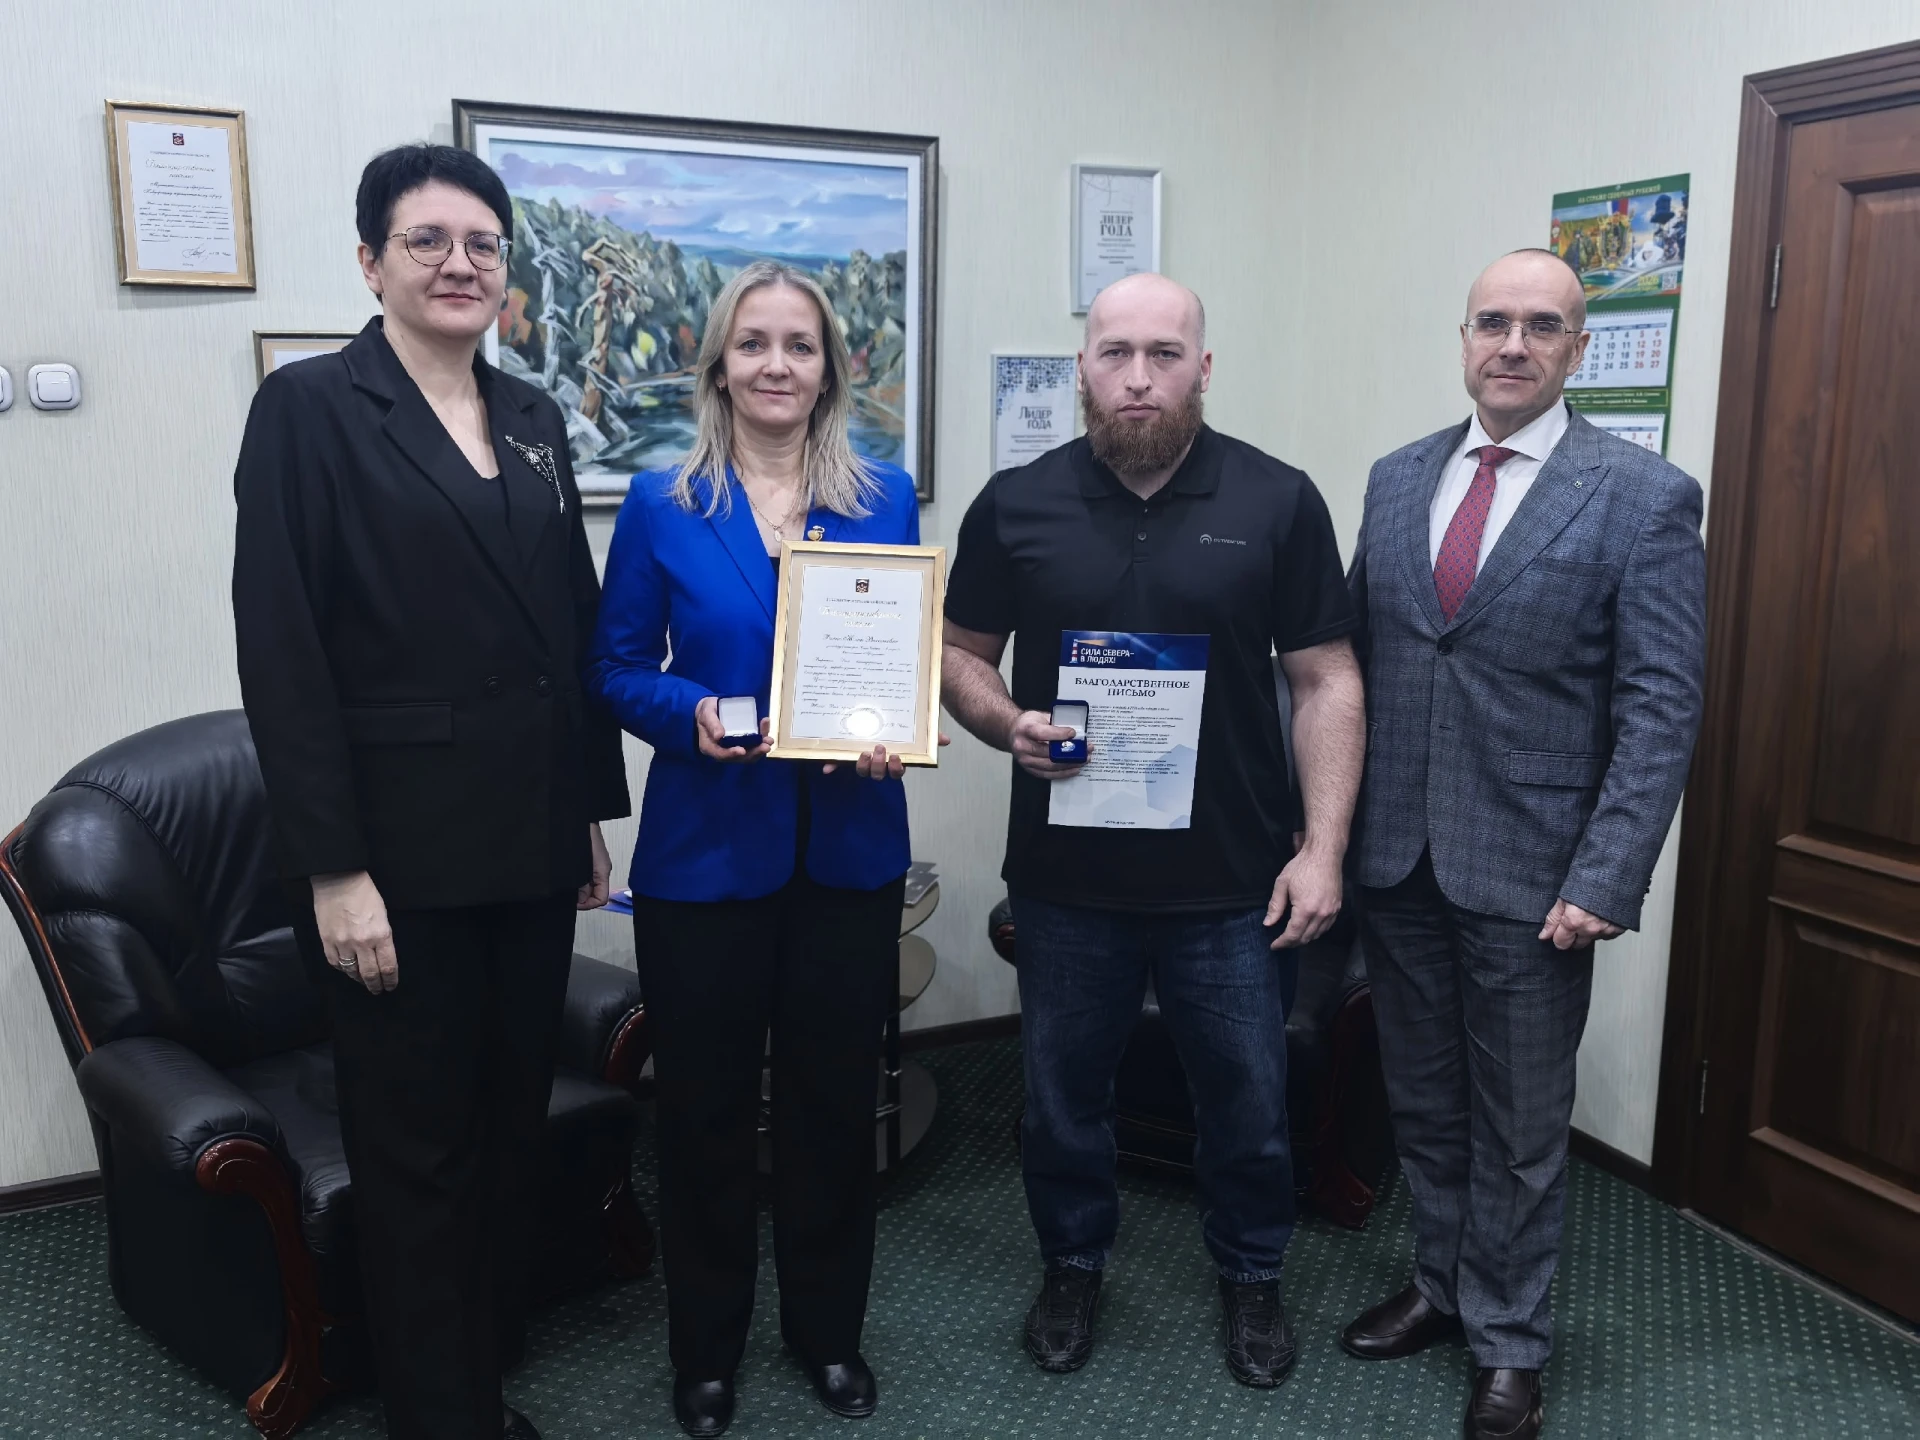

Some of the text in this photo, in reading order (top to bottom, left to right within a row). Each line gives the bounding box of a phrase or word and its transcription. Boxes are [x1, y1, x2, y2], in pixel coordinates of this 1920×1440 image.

[1100, 215, 1134, 225] ЛИДЕР
[1100, 224, 1133, 237] ГОДА
[1595, 333, 1600, 341] 2
[1624, 331, 1630, 339] 4
[1640, 330, 1645, 338] 5
[1655, 329, 1661, 337] 6
[1607, 342, 1616, 350] 10
[1622, 341, 1631, 349] 11
[1637, 340, 1646, 348] 12
[1652, 339, 1662, 347] 13
[1621, 351, 1630, 359] 18
[1651, 350, 1661, 358] 20
[1619, 361, 1629, 369] 25
[1635, 361, 1645, 369] 26
[1650, 360, 1660, 368] 27
[1647, 432, 1653, 440] 4
[1080, 648, 1101, 656] СИЛА
[1086, 656, 1117, 664] ЛЮДЯХ!
[1075, 677, 1191, 689] БЛАГОДАРСТВЕННОЕ
[1107, 688, 1157, 698] ПИСЬМО
